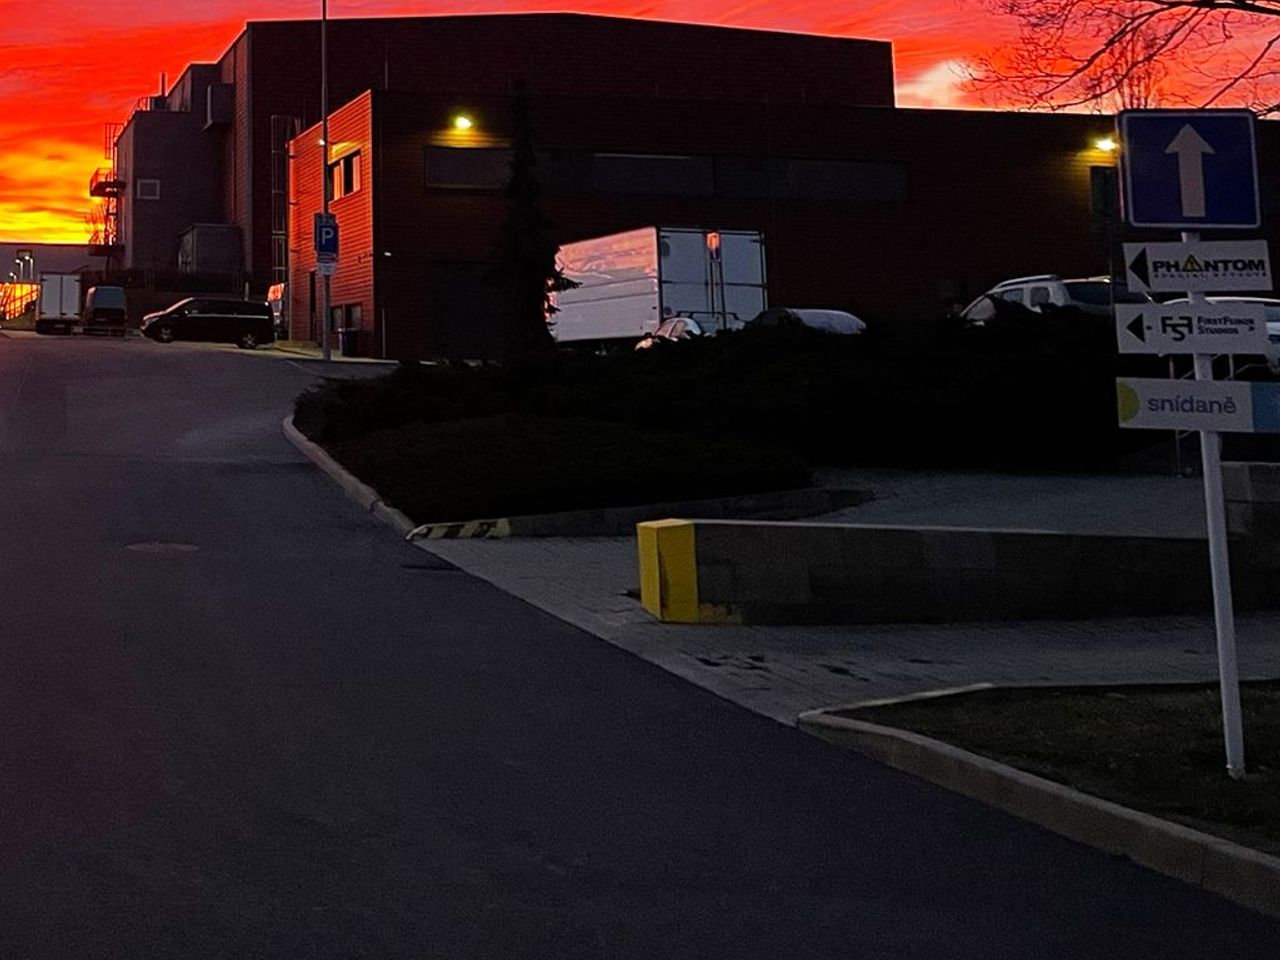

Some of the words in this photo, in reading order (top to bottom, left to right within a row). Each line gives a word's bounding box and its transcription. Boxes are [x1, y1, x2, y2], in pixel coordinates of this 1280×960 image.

[322, 227, 334, 244] P
[1152, 255, 1266, 272] PHANTOM
[1148, 395, 1237, 413] snídaně
